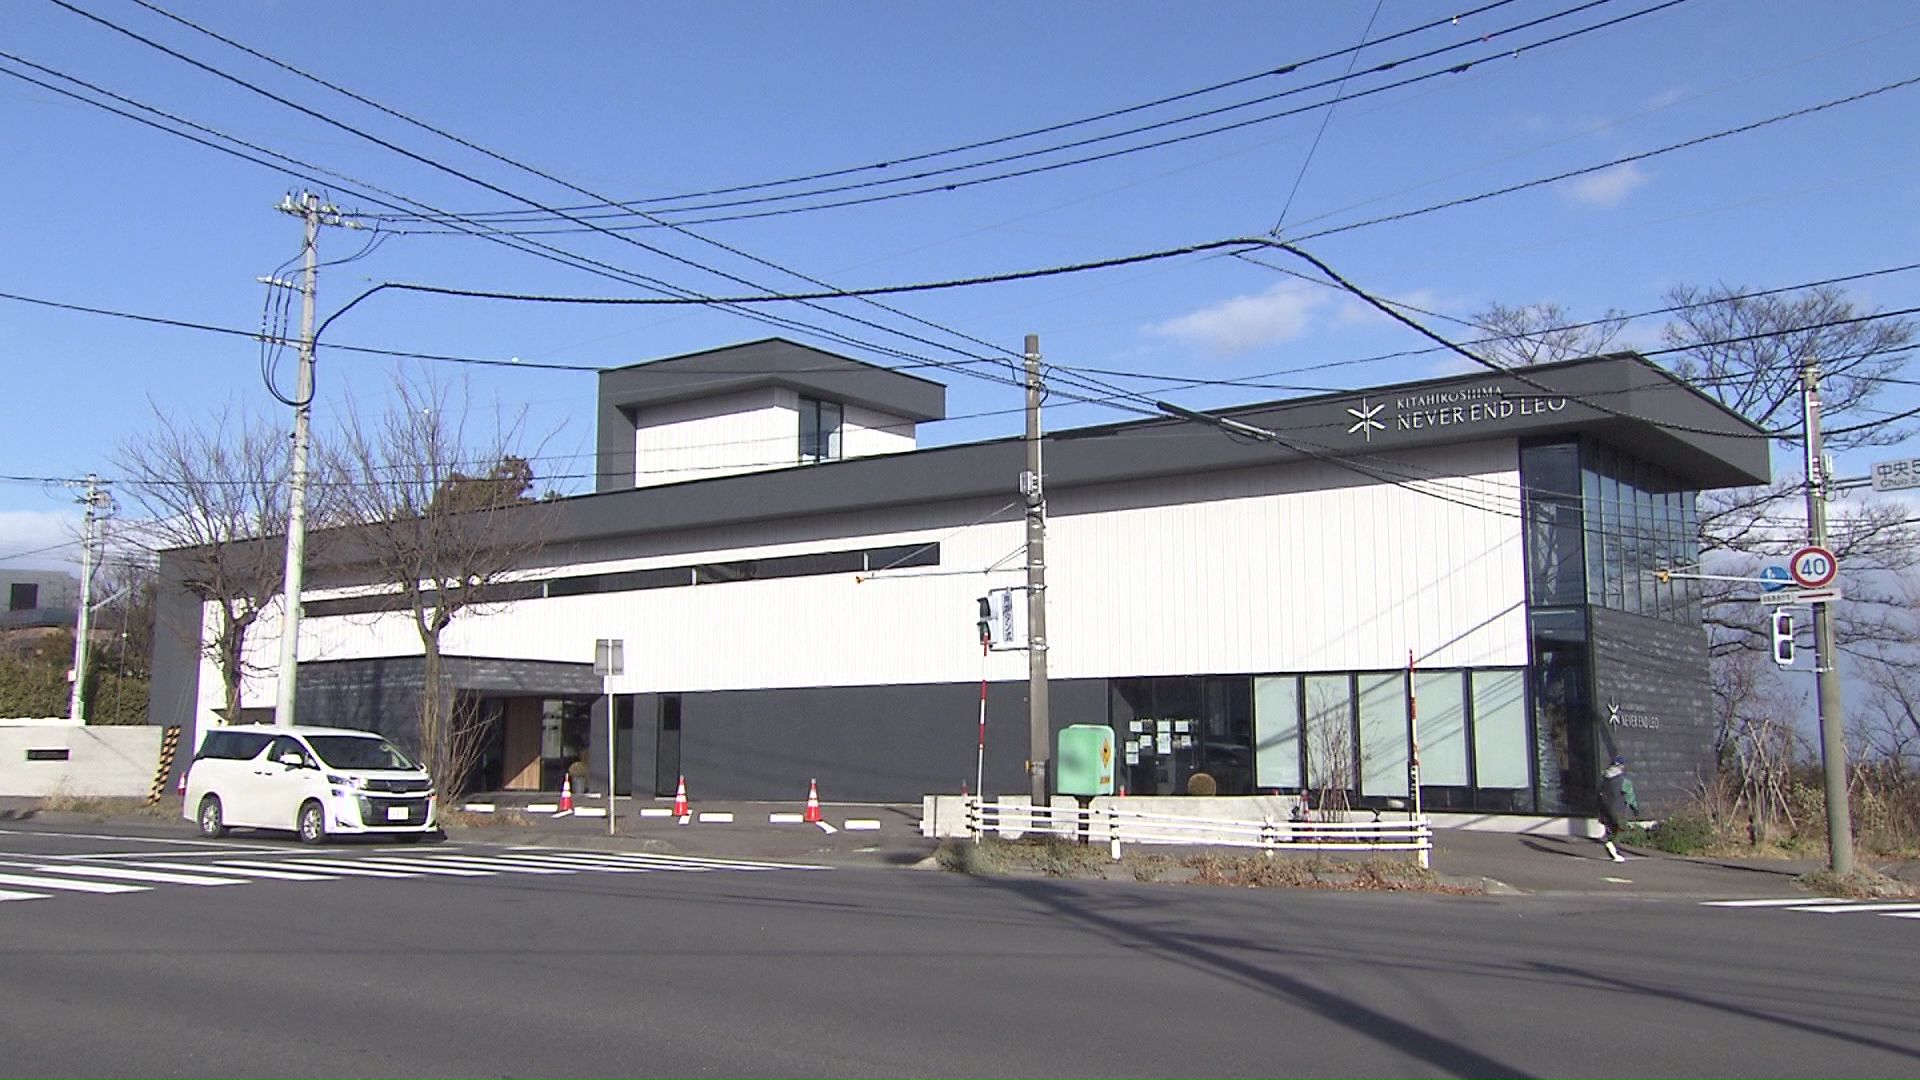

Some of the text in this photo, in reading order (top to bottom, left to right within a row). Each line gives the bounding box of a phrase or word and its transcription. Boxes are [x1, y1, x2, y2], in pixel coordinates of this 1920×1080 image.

[1396, 386, 1502, 409] KITAHIROSHIMA
[1398, 397, 1567, 431] NEVER END LEO
[1877, 459, 1920, 480] 中央5
[1801, 558, 1826, 576] 40
